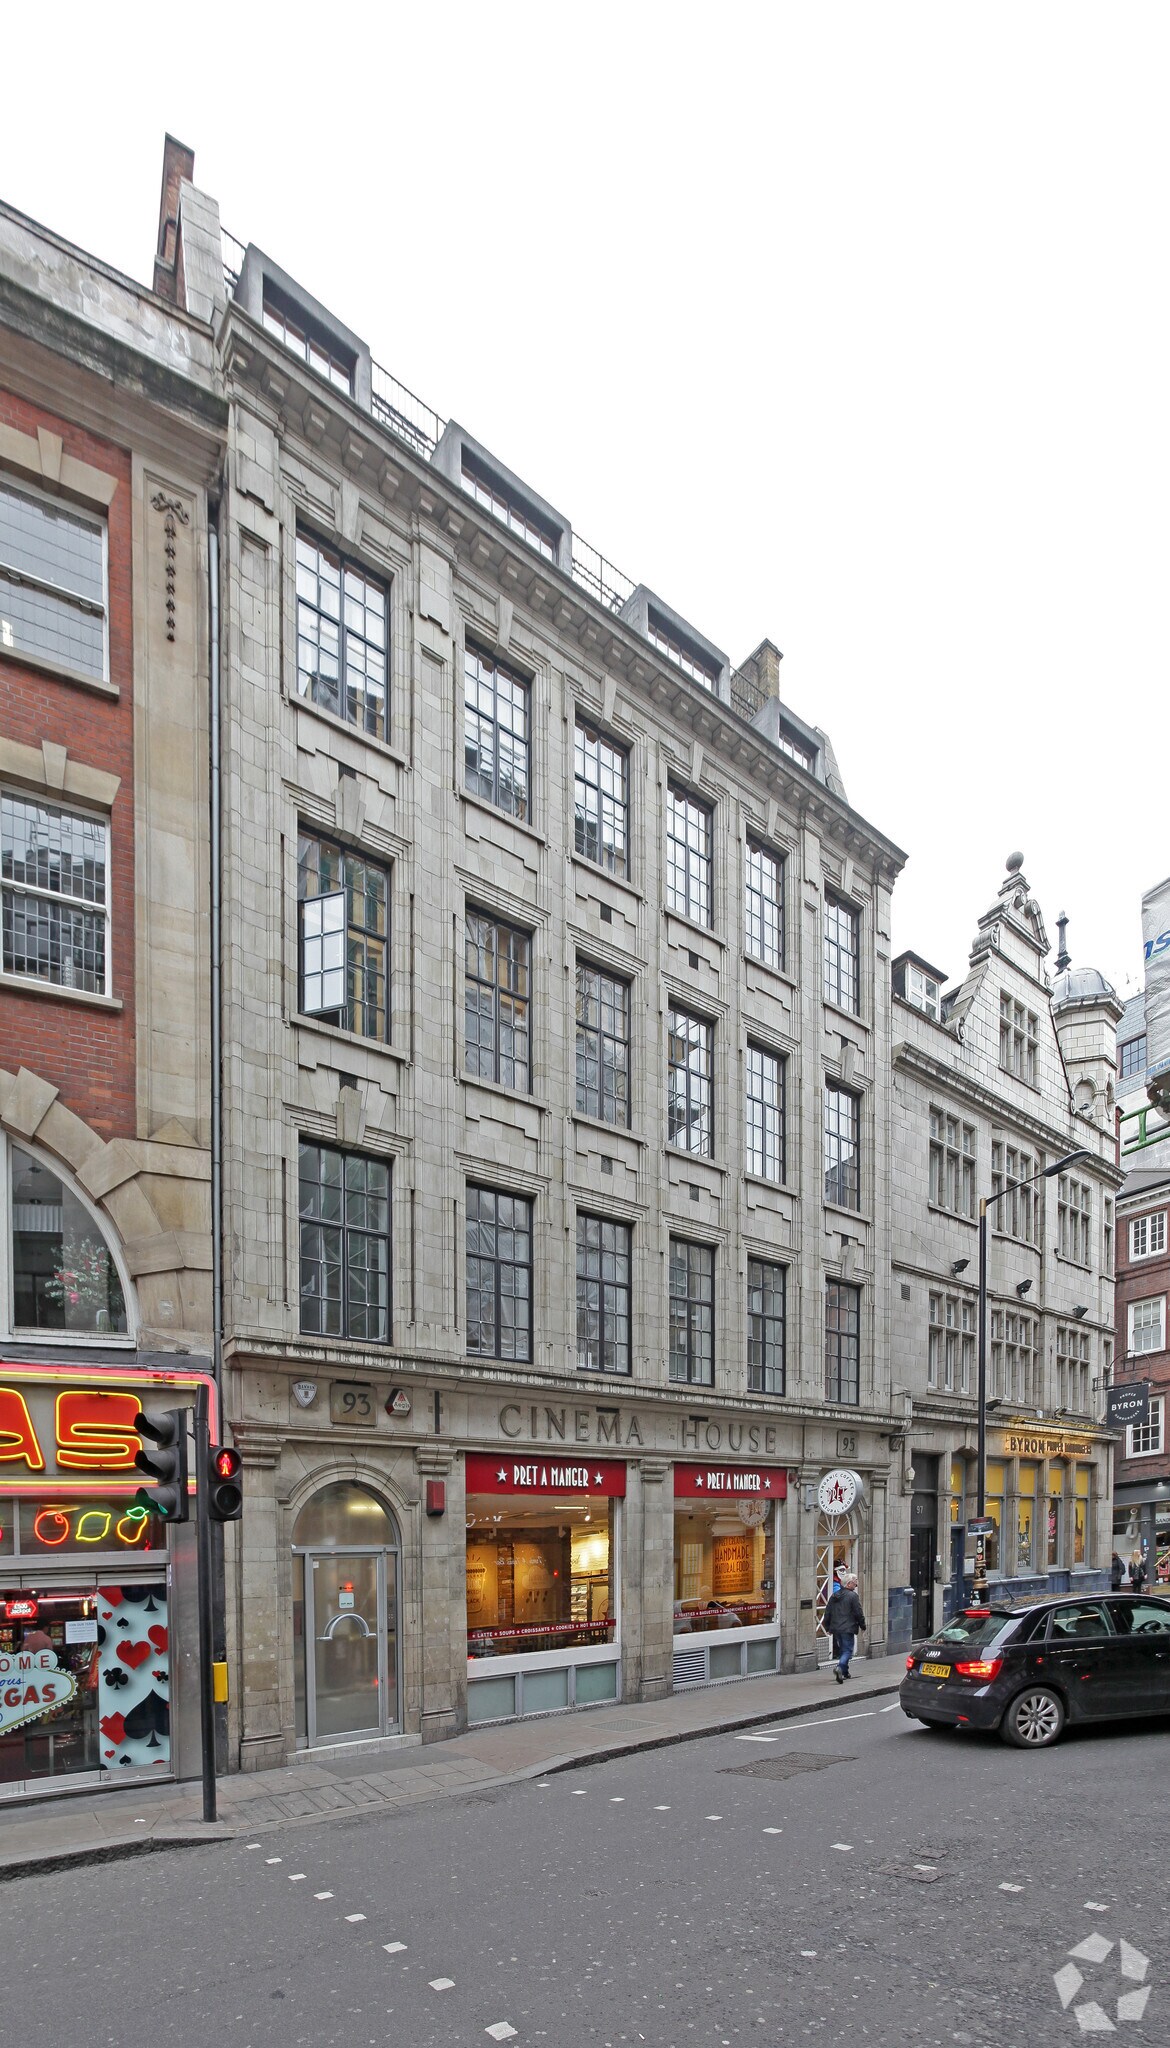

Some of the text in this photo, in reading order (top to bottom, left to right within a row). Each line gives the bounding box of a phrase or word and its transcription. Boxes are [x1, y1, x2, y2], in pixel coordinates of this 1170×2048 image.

[342, 1393, 371, 1416] 93
[1111, 1400, 1143, 1411] BYRON
[500, 1404, 777, 1453] CINEMA HOUSE
[843, 1437, 855, 1452] 95
[1010, 1436, 1044, 1454] BYRON
[513, 1465, 589, 1487] PRET A MANGER
[707, 1472, 761, 1491] PRET A MANGER
[840, 1473, 854, 1490] COFFEE
[821, 1500, 840, 1513] NATURAL
[916, 1505, 924, 1514] 97
[714, 1545, 750, 1561] HANDMADE
[477, 1631, 493, 1639] LATTE
[499, 1629, 516, 1637] SOUPS
[521, 1626, 551, 1634] CROISSANTS
